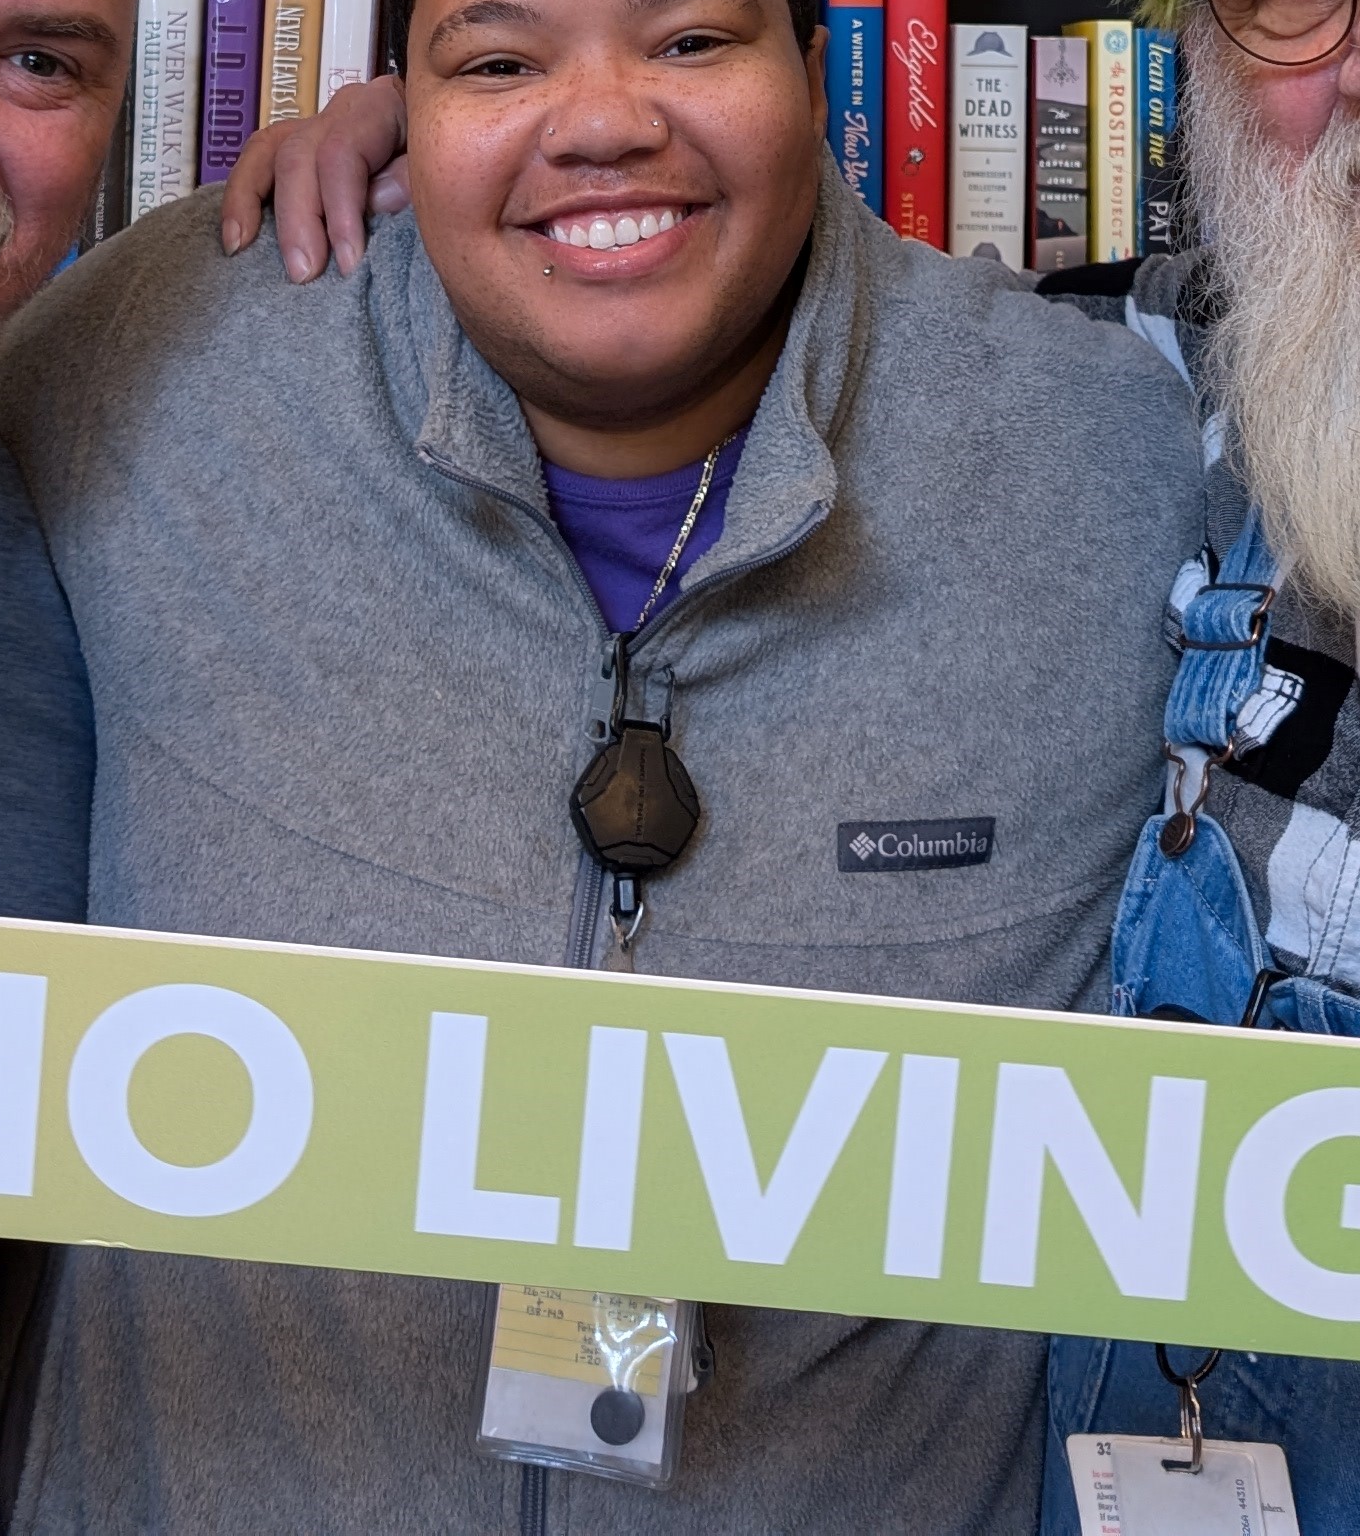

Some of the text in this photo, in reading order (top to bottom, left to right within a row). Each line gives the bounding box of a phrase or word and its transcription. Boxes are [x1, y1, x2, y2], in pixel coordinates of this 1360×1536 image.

[852, 19, 863, 105] A WINTER IN
[162, 11, 187, 155] NEVER WALK
[892, 18, 937, 132] Eligible
[140, 21, 161, 163] PAULA DETMER
[976, 79, 1001, 92] THE
[965, 100, 1012, 117] DEAD
[959, 123, 1018, 140] WITNESS
[1041, 126, 1079, 135] RETURN
[1039, 159, 1081, 168] CAPTAIN
[1047, 177, 1073, 185] JOHN
[1040, 193, 1079, 202] EMMETT
[878, 832, 988, 857] Columbia
